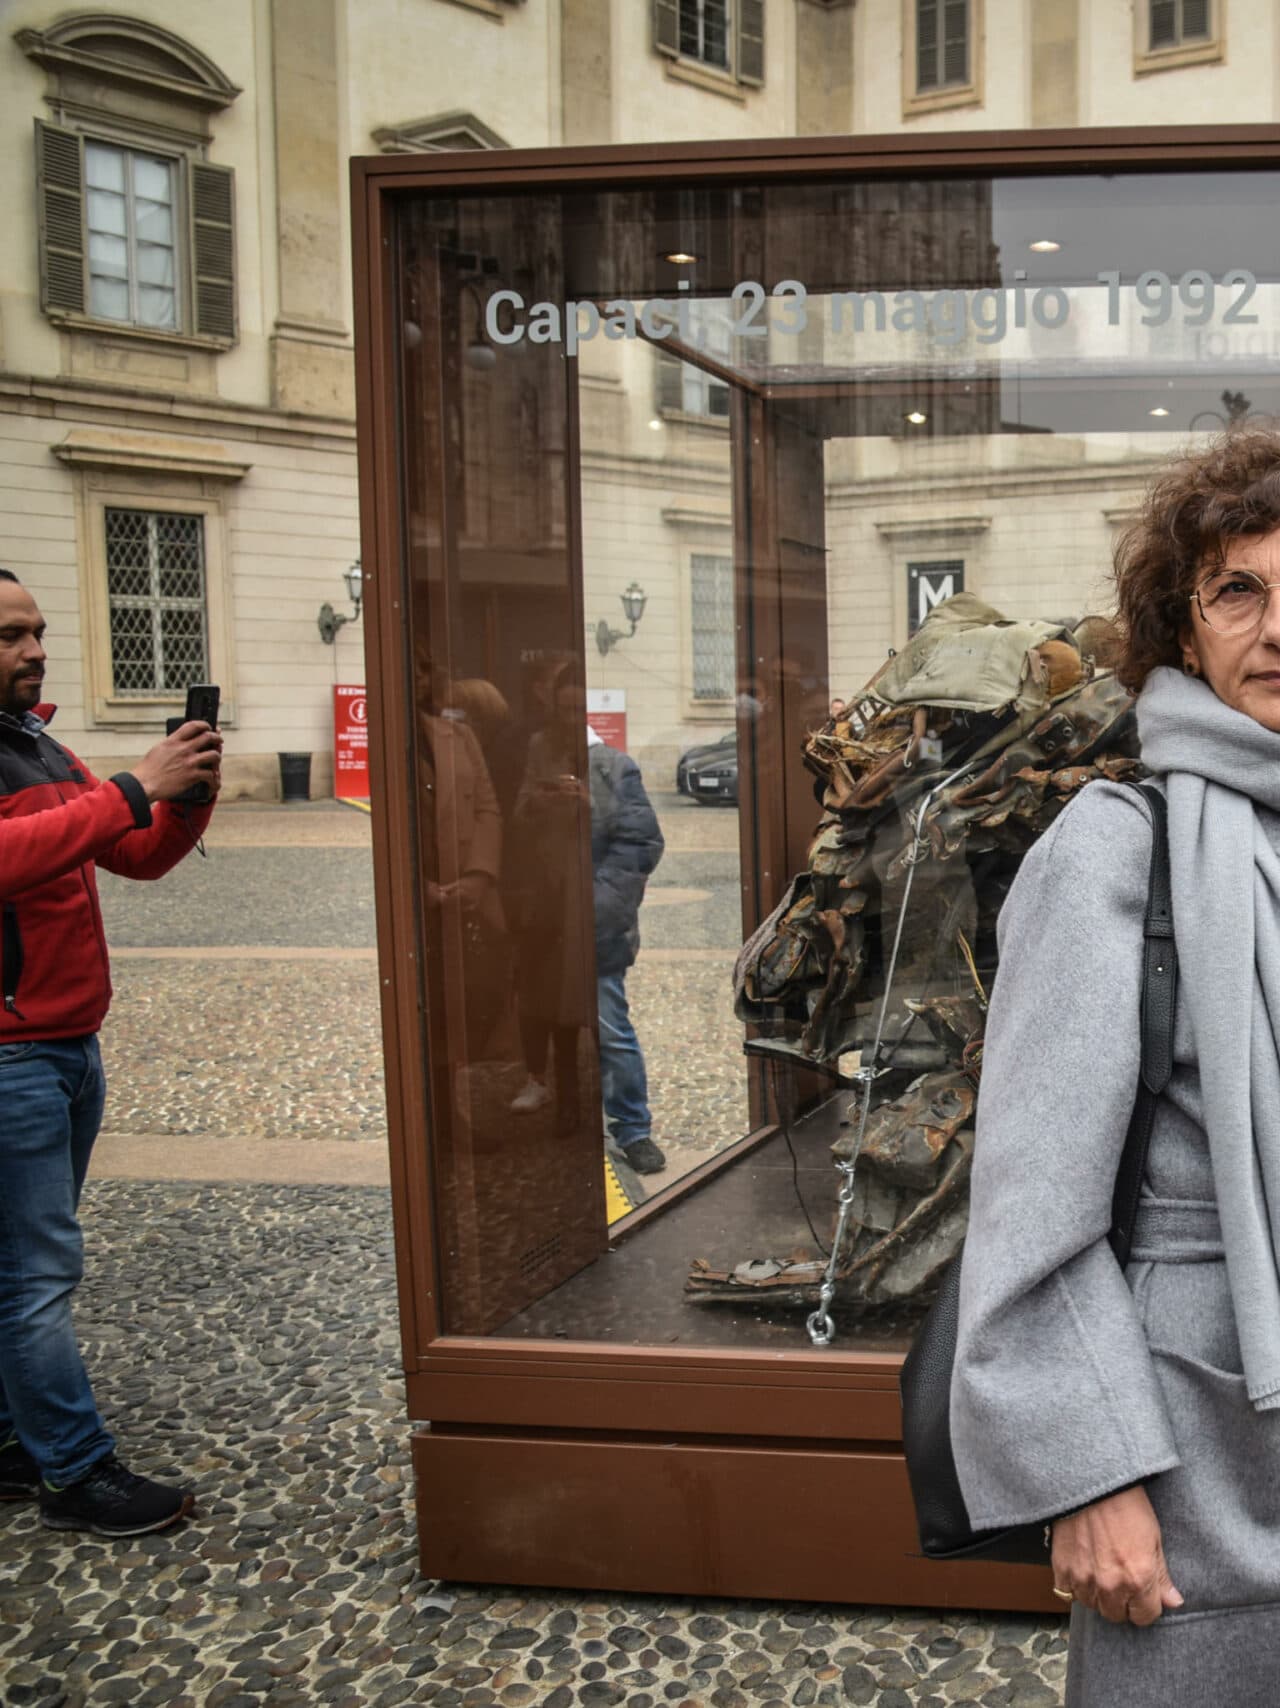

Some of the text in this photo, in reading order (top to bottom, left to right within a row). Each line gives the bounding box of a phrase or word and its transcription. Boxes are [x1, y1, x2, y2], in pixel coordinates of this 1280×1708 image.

[731, 279, 808, 336] 23
[830, 269, 1071, 346] maggio
[1098, 269, 1259, 328] 1992
[919, 574, 954, 625] M
